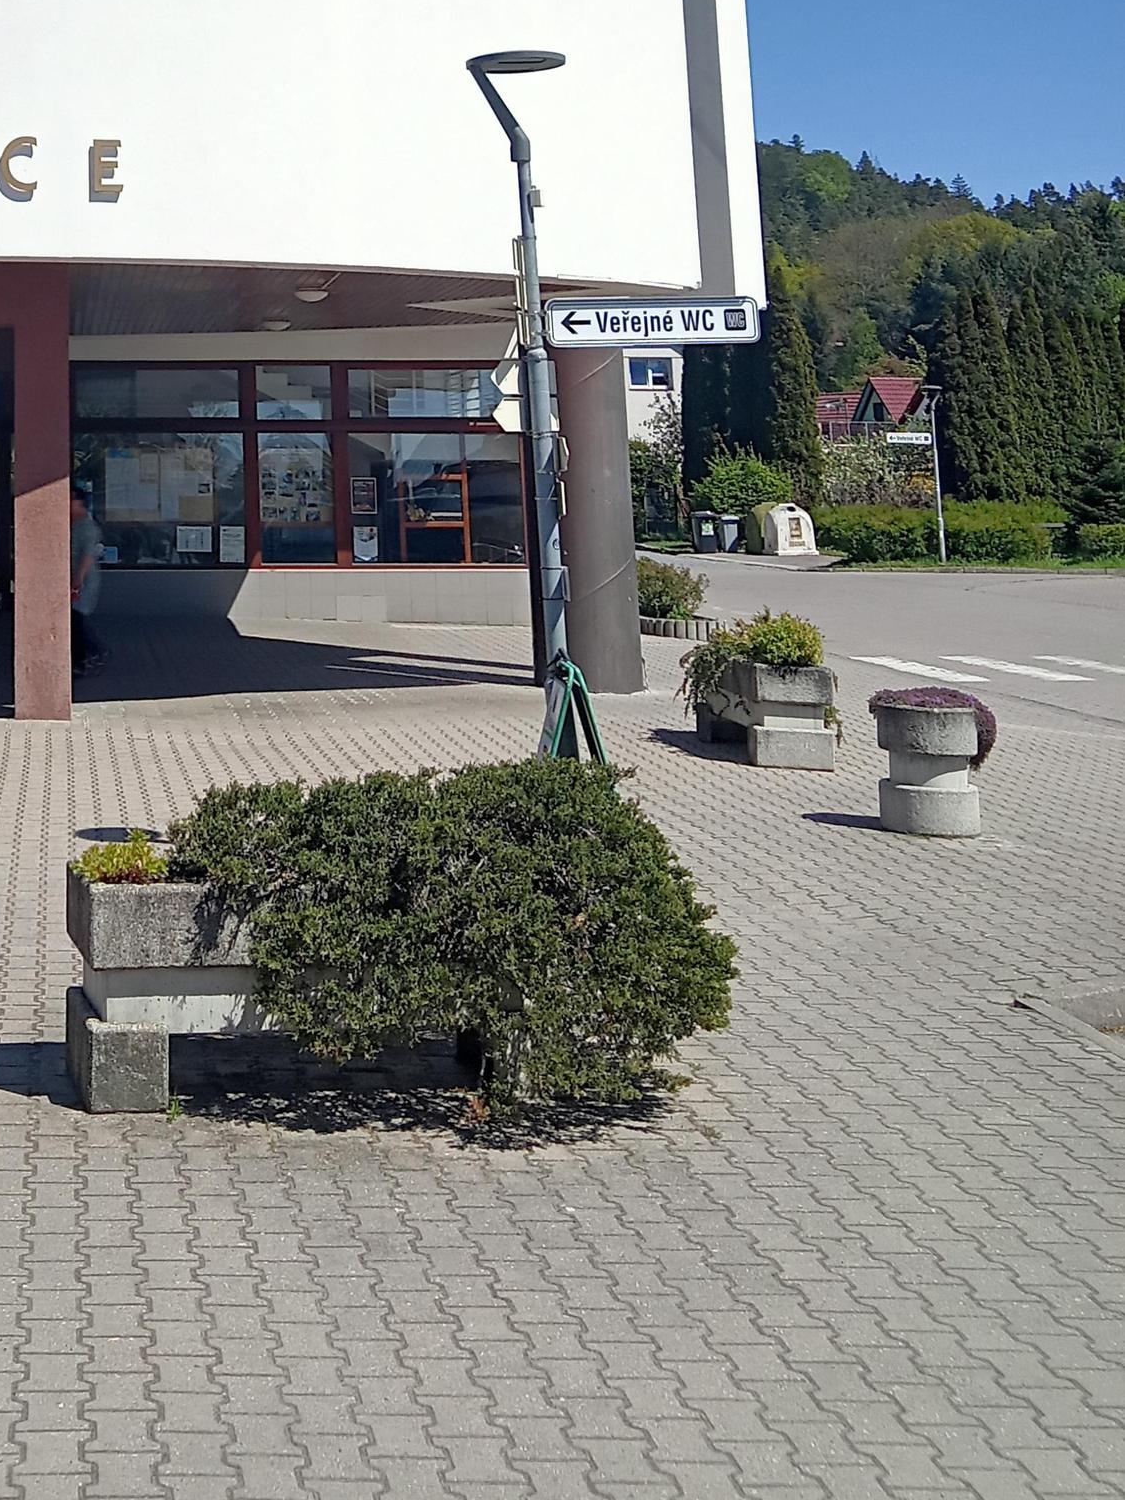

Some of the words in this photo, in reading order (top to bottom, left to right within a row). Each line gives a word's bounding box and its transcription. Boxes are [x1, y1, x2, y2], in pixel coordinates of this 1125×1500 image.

[595, 310, 674, 337] Veřejné
[680, 309, 715, 331] WC
[726, 311, 746, 328] WC
